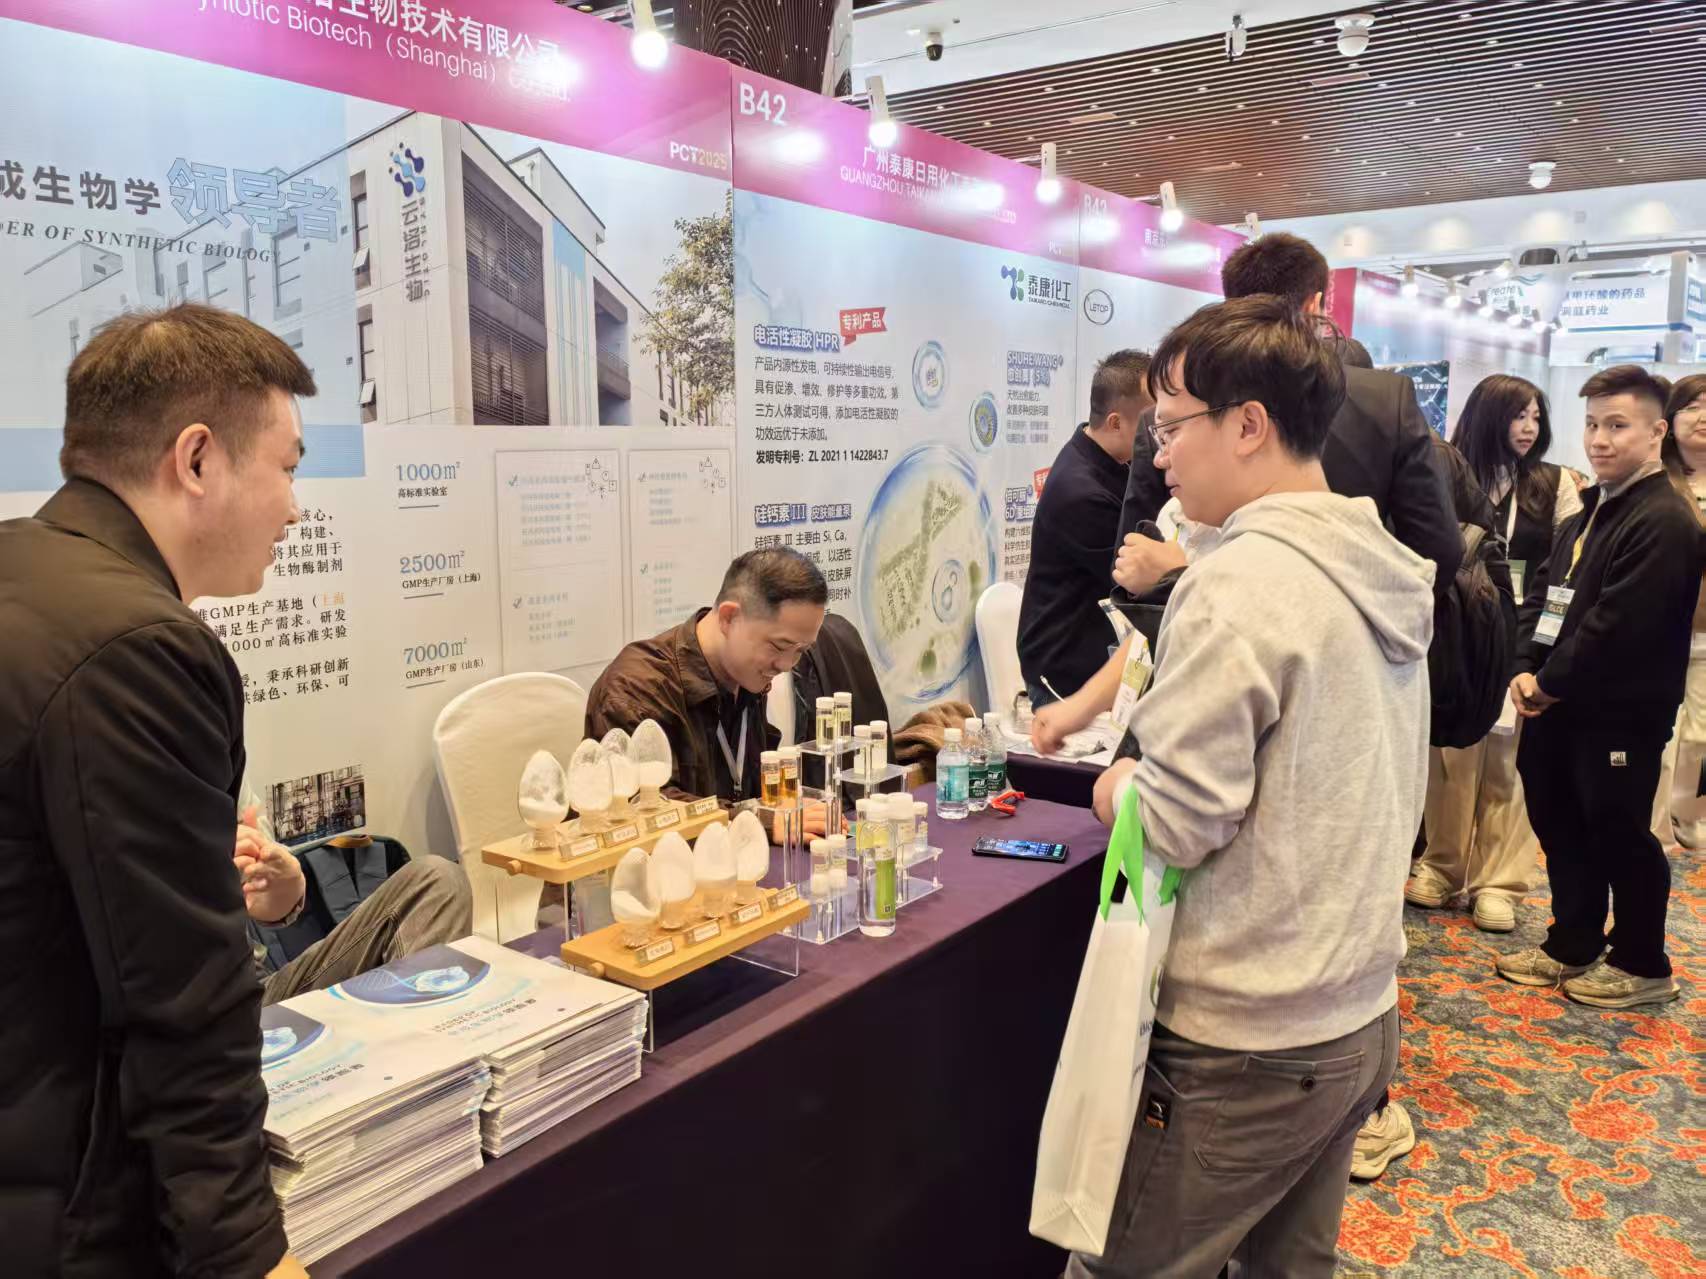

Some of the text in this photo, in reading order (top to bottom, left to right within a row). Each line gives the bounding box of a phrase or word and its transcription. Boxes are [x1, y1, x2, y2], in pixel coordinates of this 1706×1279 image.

[287, 5, 374, 49] Biotech
[738, 82, 786, 126] B42
[166, 157, 341, 242] 领导者
[0, 220, 35, 238] ER
[45, 224, 75, 241] OF
[82, 228, 198, 255] SYNTHETIC
[1028, 275, 1071, 302] 泰康化工
[842, 312, 881, 330] 专利产品
[815, 332, 839, 350] HPR
[808, 450, 819, 462] ZL
[821, 450, 840, 462] 2021
[796, 531, 821, 547] 主要由
[274, 558, 344, 577] 生物酶制剂
